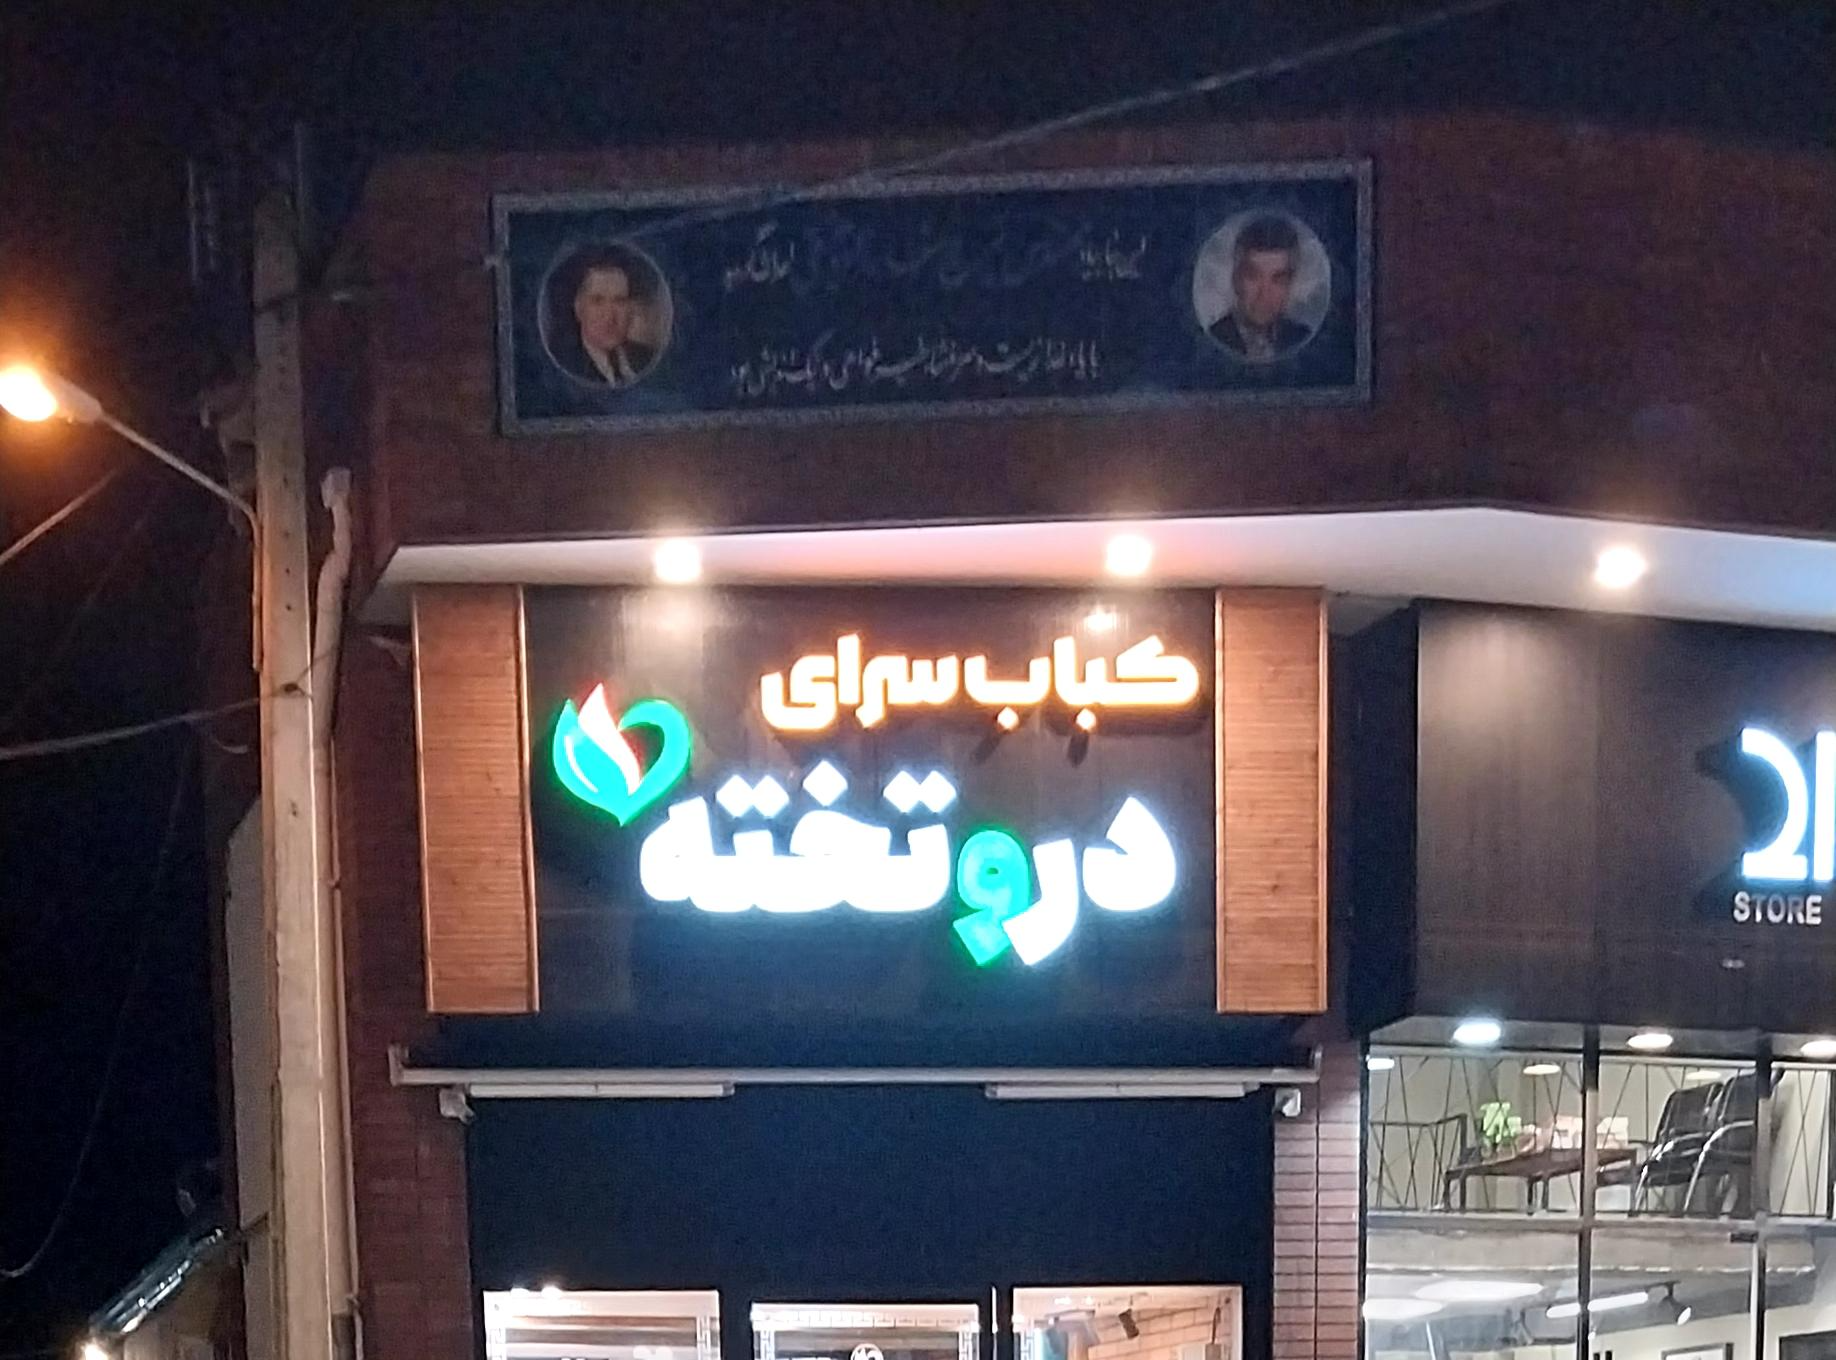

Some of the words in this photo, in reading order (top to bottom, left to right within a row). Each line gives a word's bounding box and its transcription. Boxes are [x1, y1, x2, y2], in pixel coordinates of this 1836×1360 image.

[760, 633, 960, 732] سرای
[965, 635, 1201, 733] کباب
[638, 759, 956, 912] تخته
[1732, 890, 1823, 925] STORE
